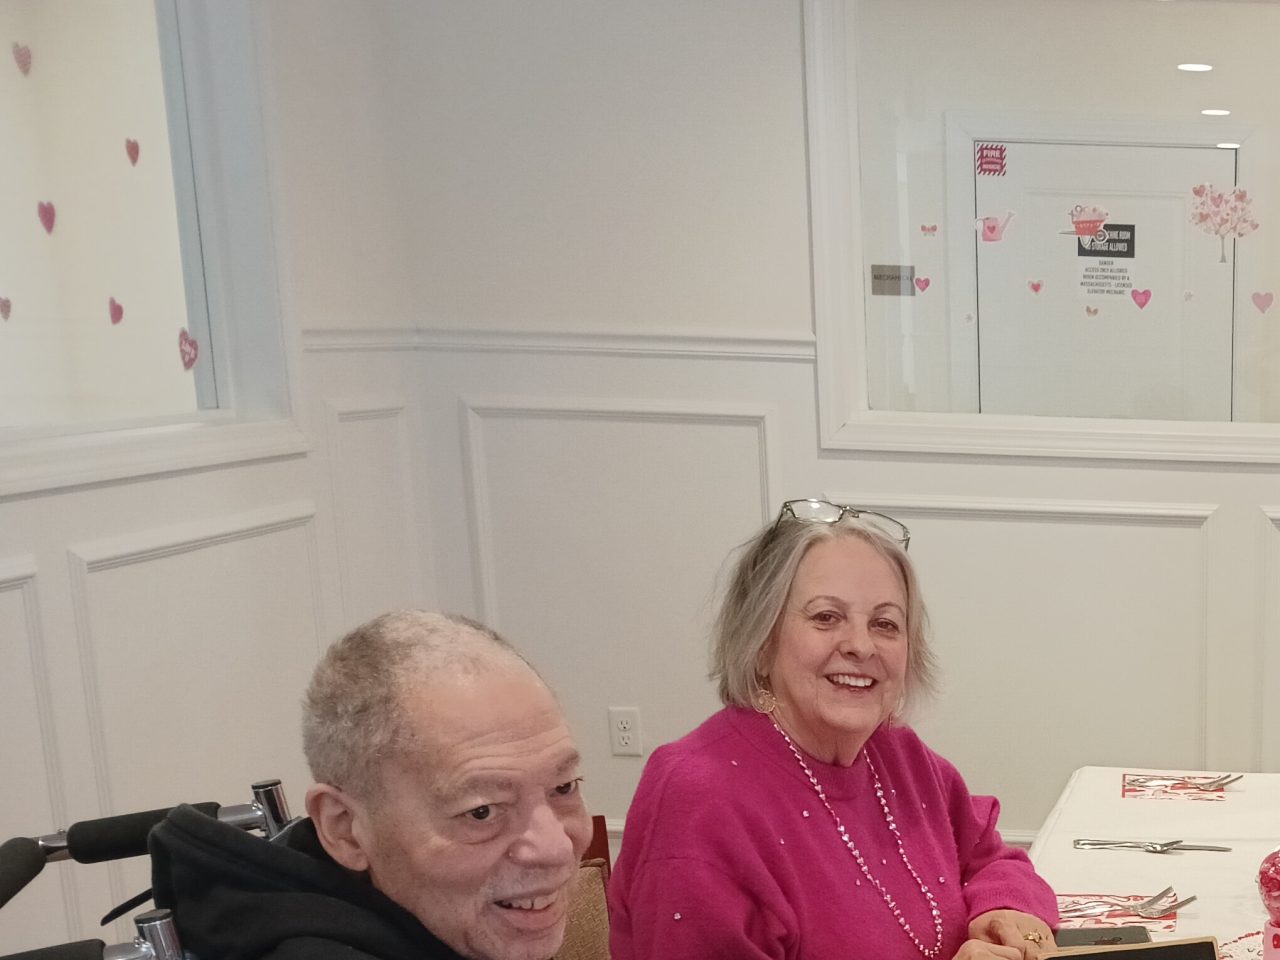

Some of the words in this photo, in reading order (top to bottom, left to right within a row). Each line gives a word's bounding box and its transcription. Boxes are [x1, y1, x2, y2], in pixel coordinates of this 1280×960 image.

[983, 149, 1001, 157] FIRE
[1120, 231, 1130, 240] ROOM
[1109, 242, 1128, 251] ALLOWED
